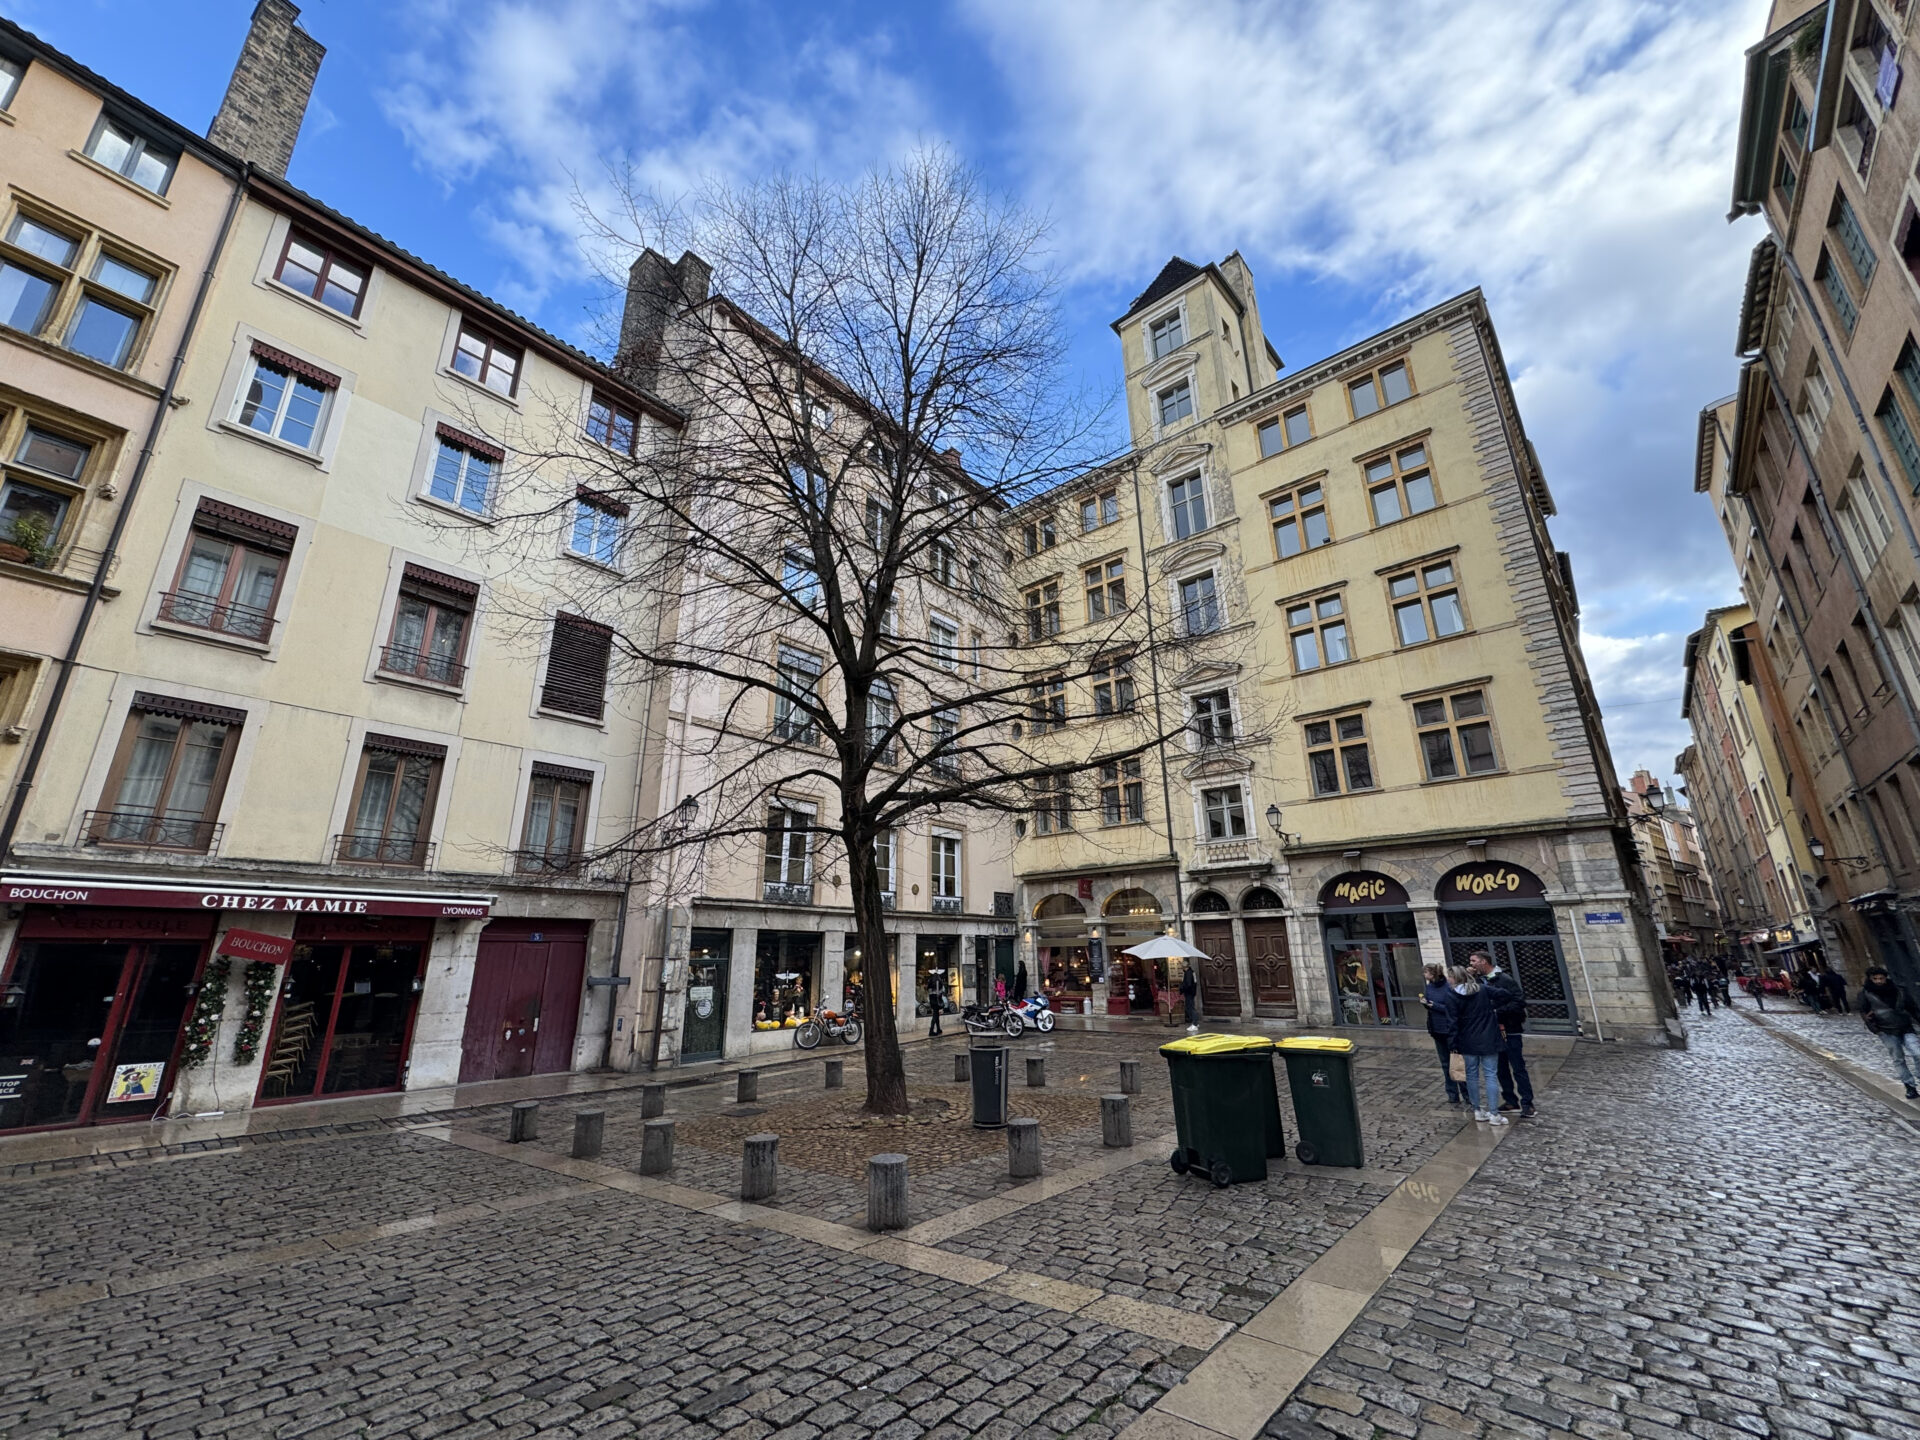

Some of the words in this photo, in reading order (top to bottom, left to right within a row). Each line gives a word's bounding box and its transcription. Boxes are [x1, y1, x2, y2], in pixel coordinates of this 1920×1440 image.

[1455, 868, 1520, 895] WORLD
[9, 887, 89, 901] BOUCHON
[201, 894, 276, 910] CHEZ
[283, 898, 368, 913] MAMIE
[442, 906, 483, 916] LYONNAIS
[230, 937, 284, 955] BOUCHON
